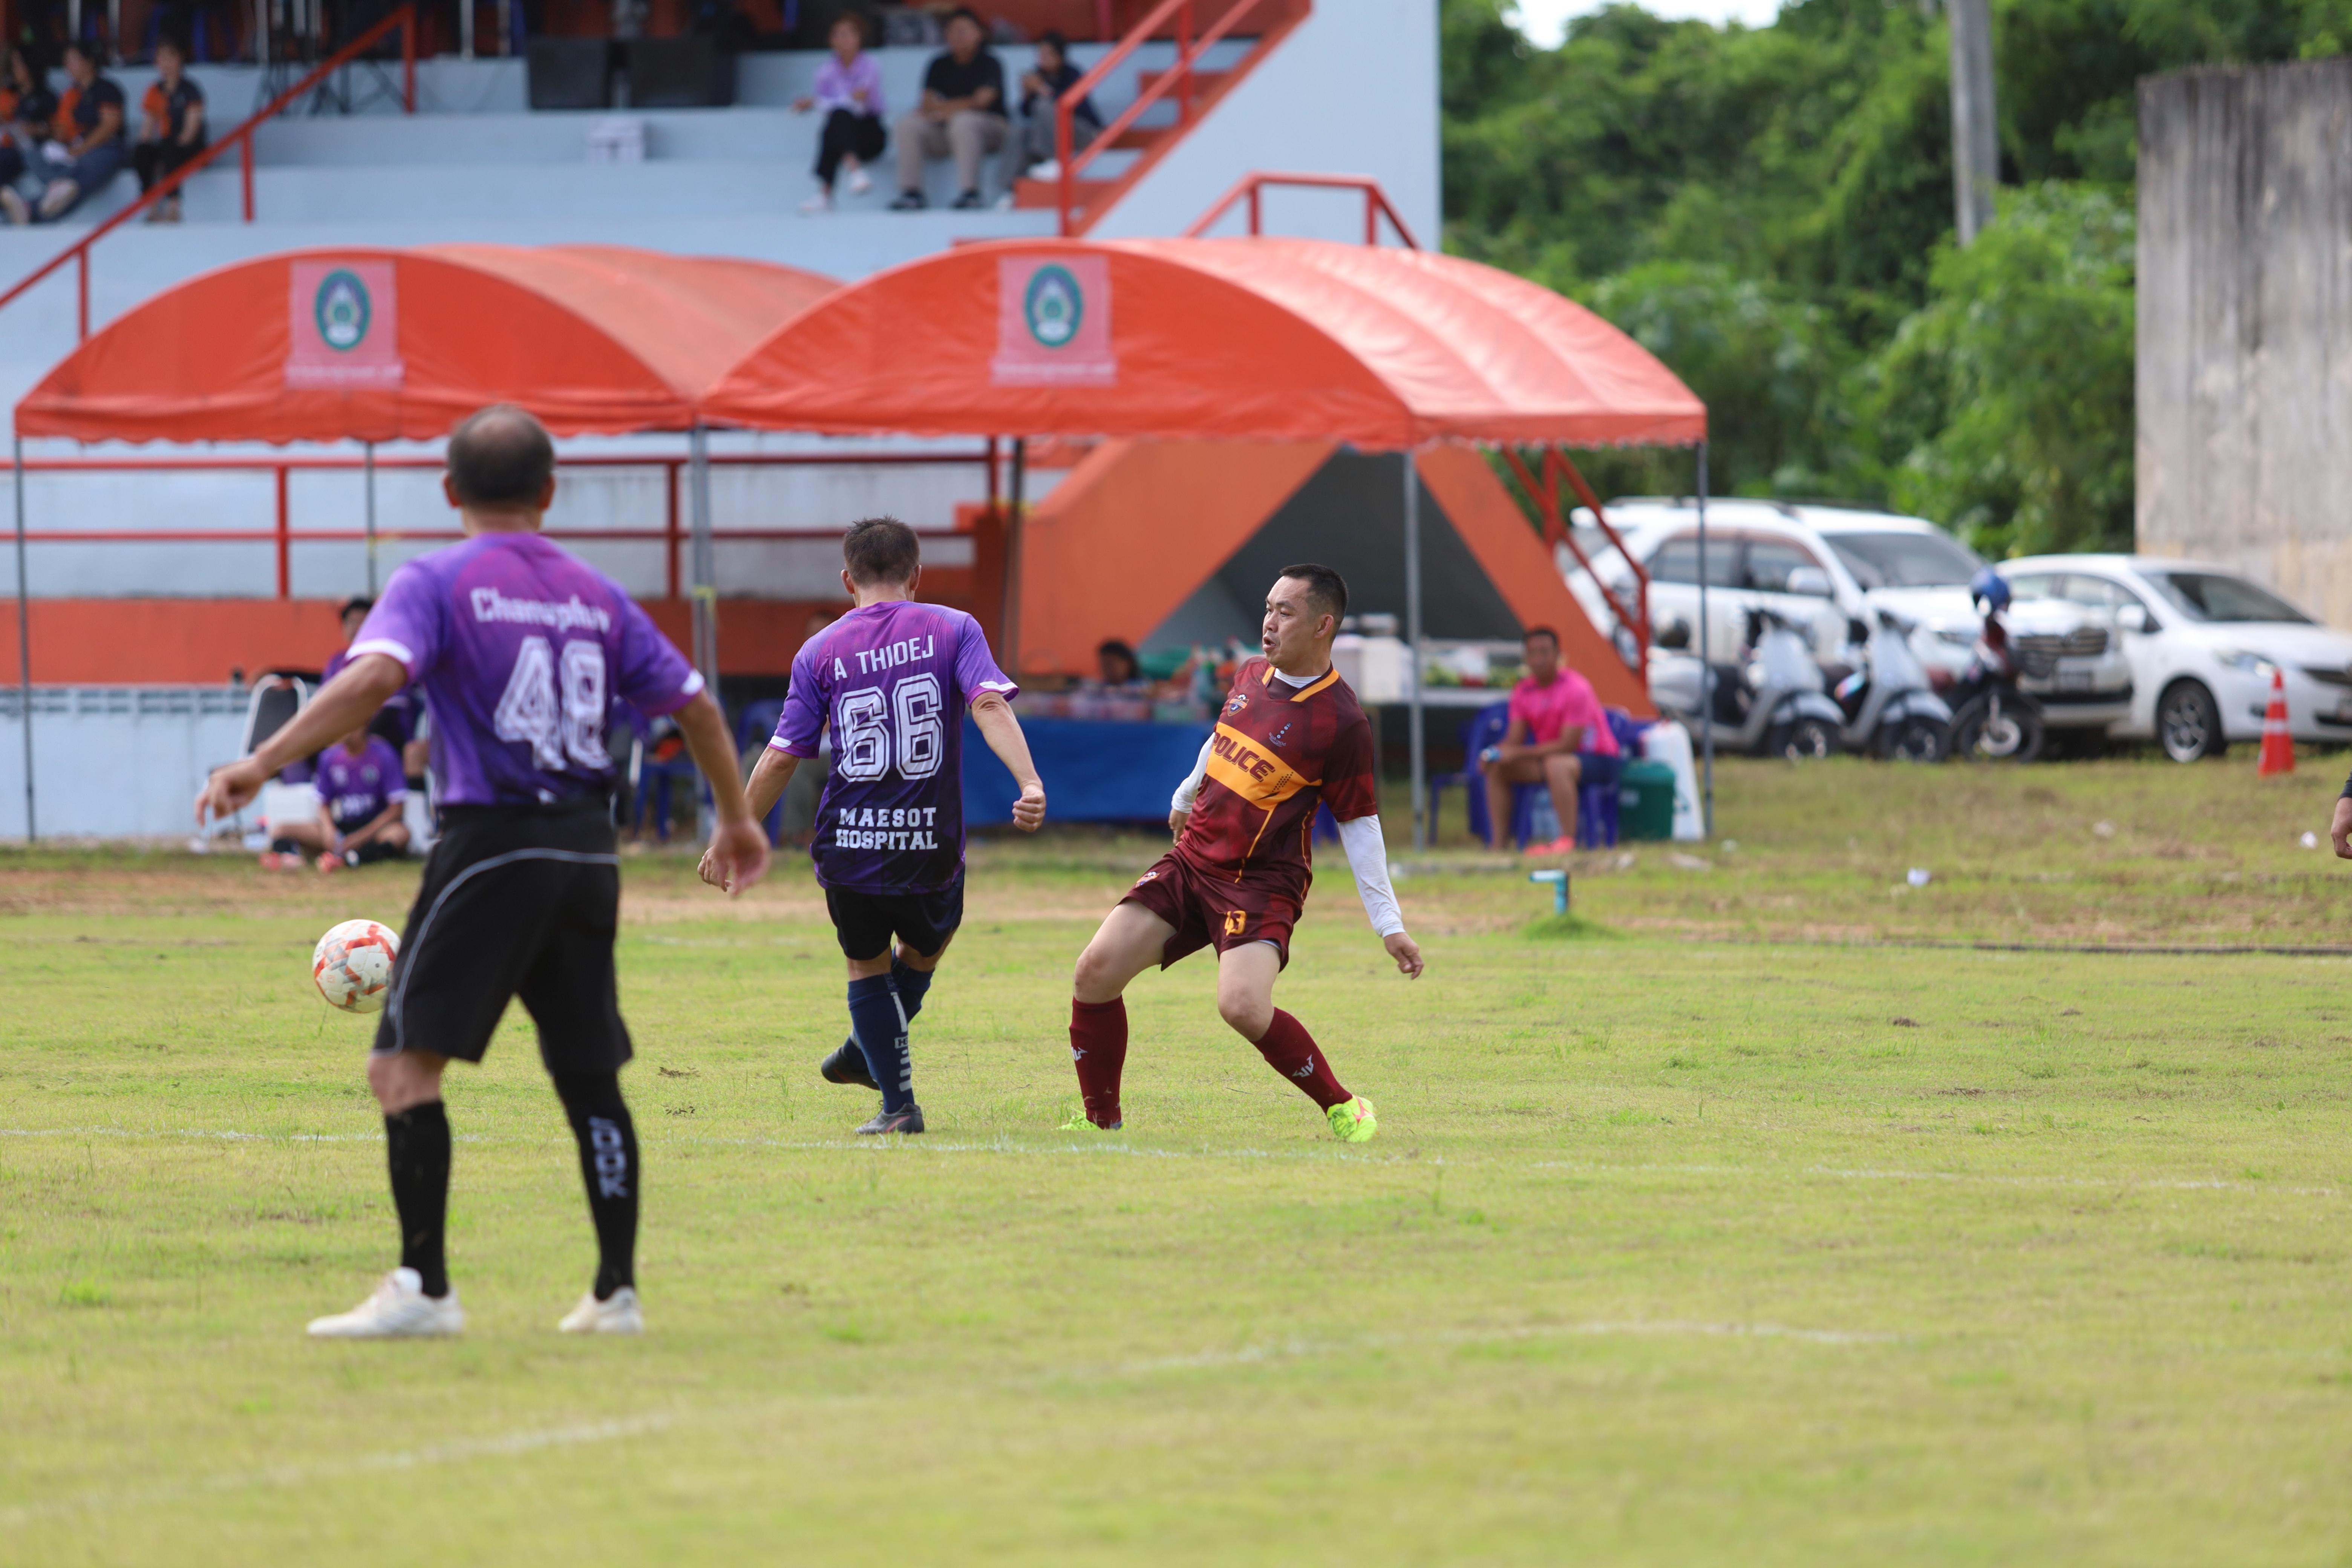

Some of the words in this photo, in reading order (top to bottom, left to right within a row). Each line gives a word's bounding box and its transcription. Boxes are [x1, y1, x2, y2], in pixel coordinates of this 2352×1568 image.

[835, 657, 848, 681] A
[855, 635, 934, 674] THIDEJ
[837, 672, 943, 782] 66
[1213, 732, 1276, 782] POLICE
[836, 829, 938, 850] HOSPITAL
[839, 807, 936, 827] MAESOT
